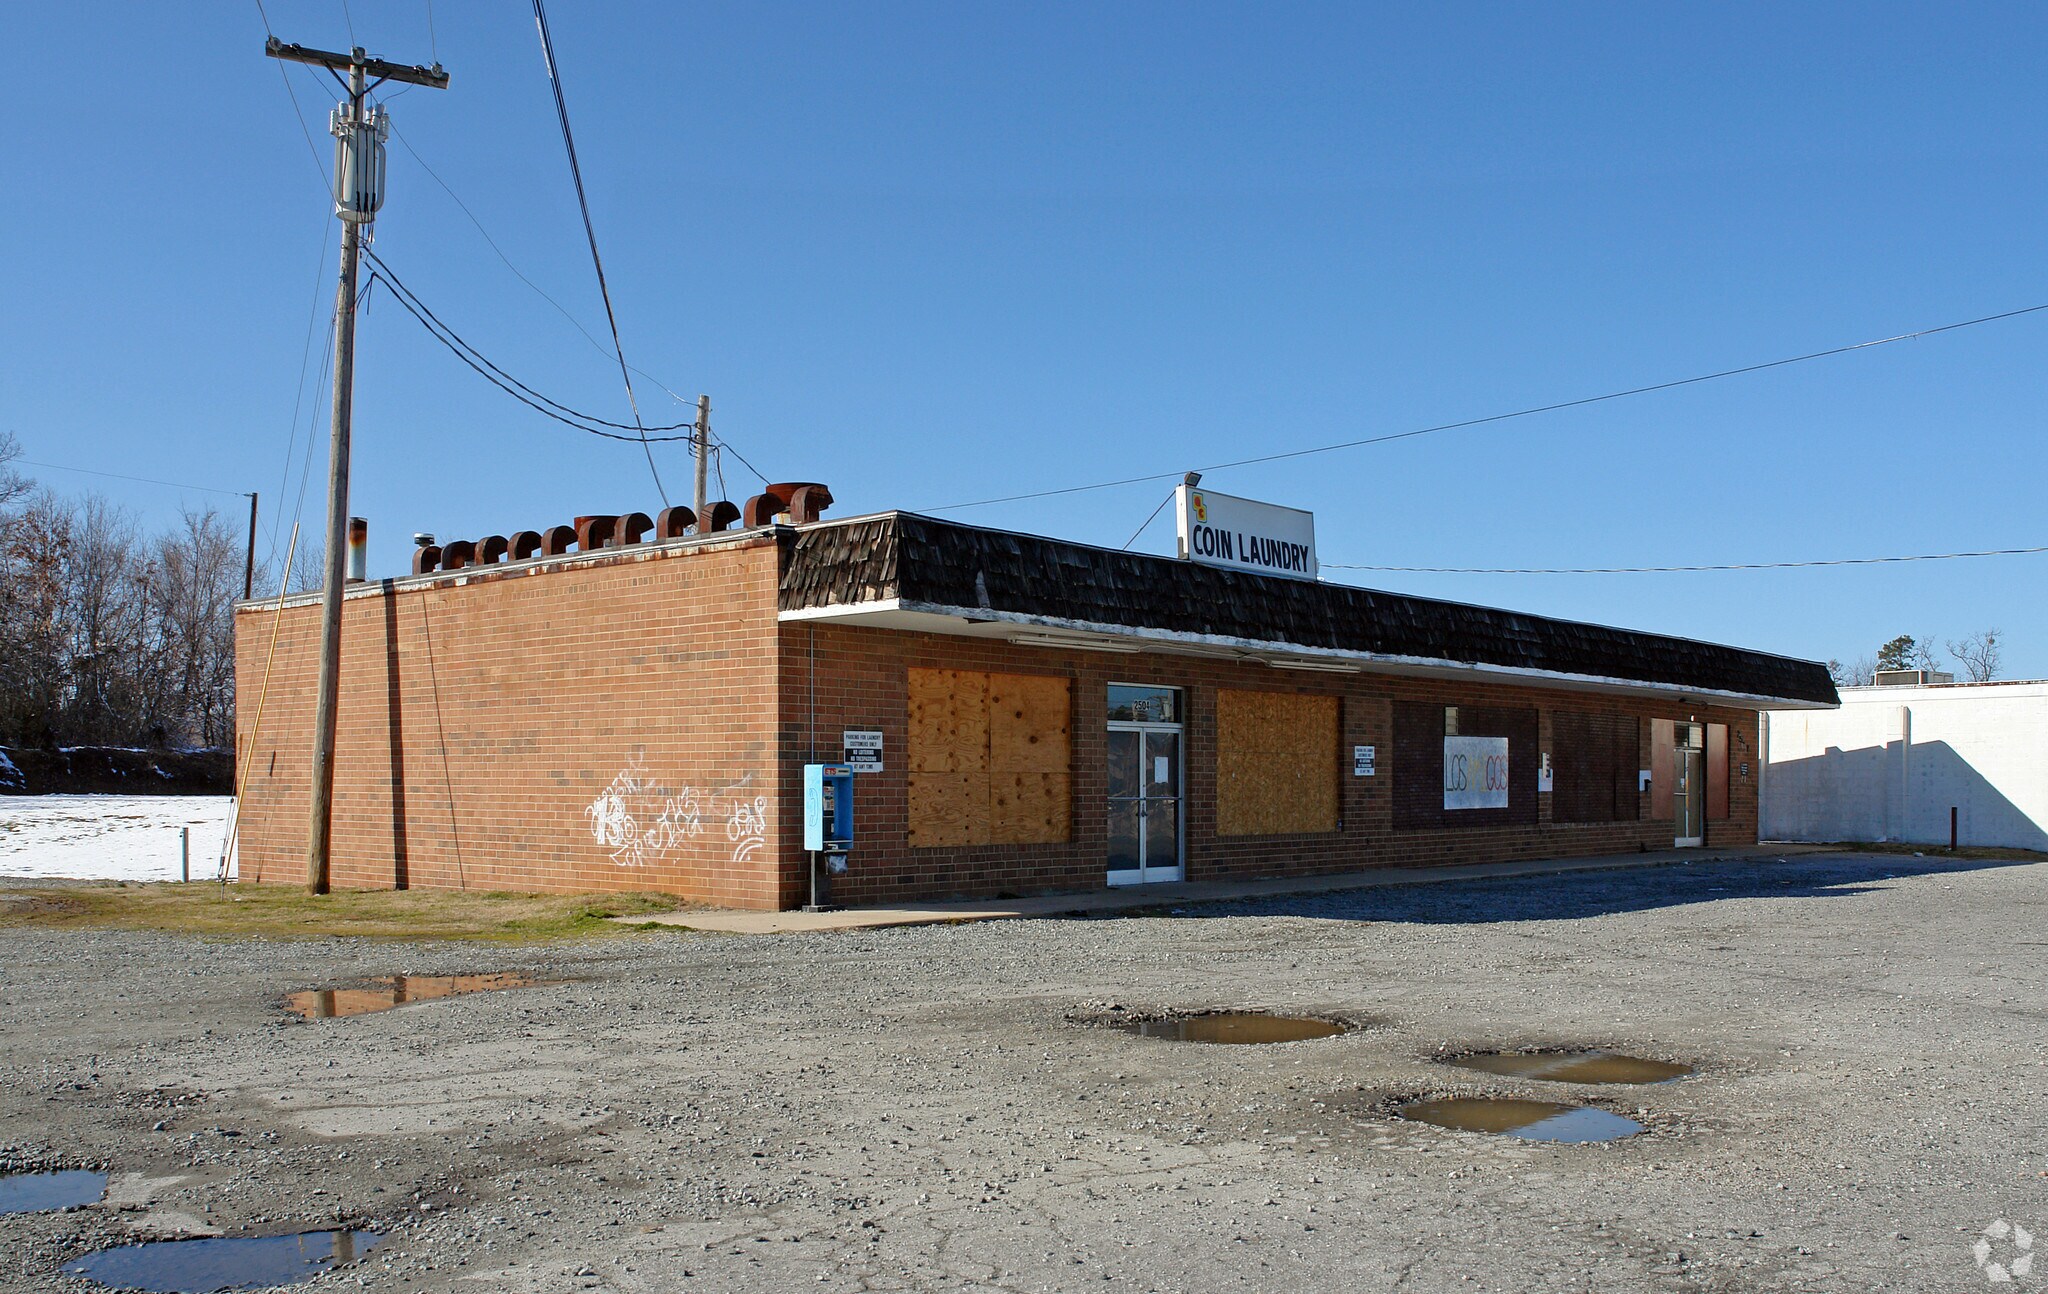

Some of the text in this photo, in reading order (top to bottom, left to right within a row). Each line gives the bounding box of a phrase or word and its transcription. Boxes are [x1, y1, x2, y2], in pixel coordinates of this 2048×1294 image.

[1193, 524, 1309, 573] COIN LAUNDRY
[1445, 753, 1468, 792] LOS
